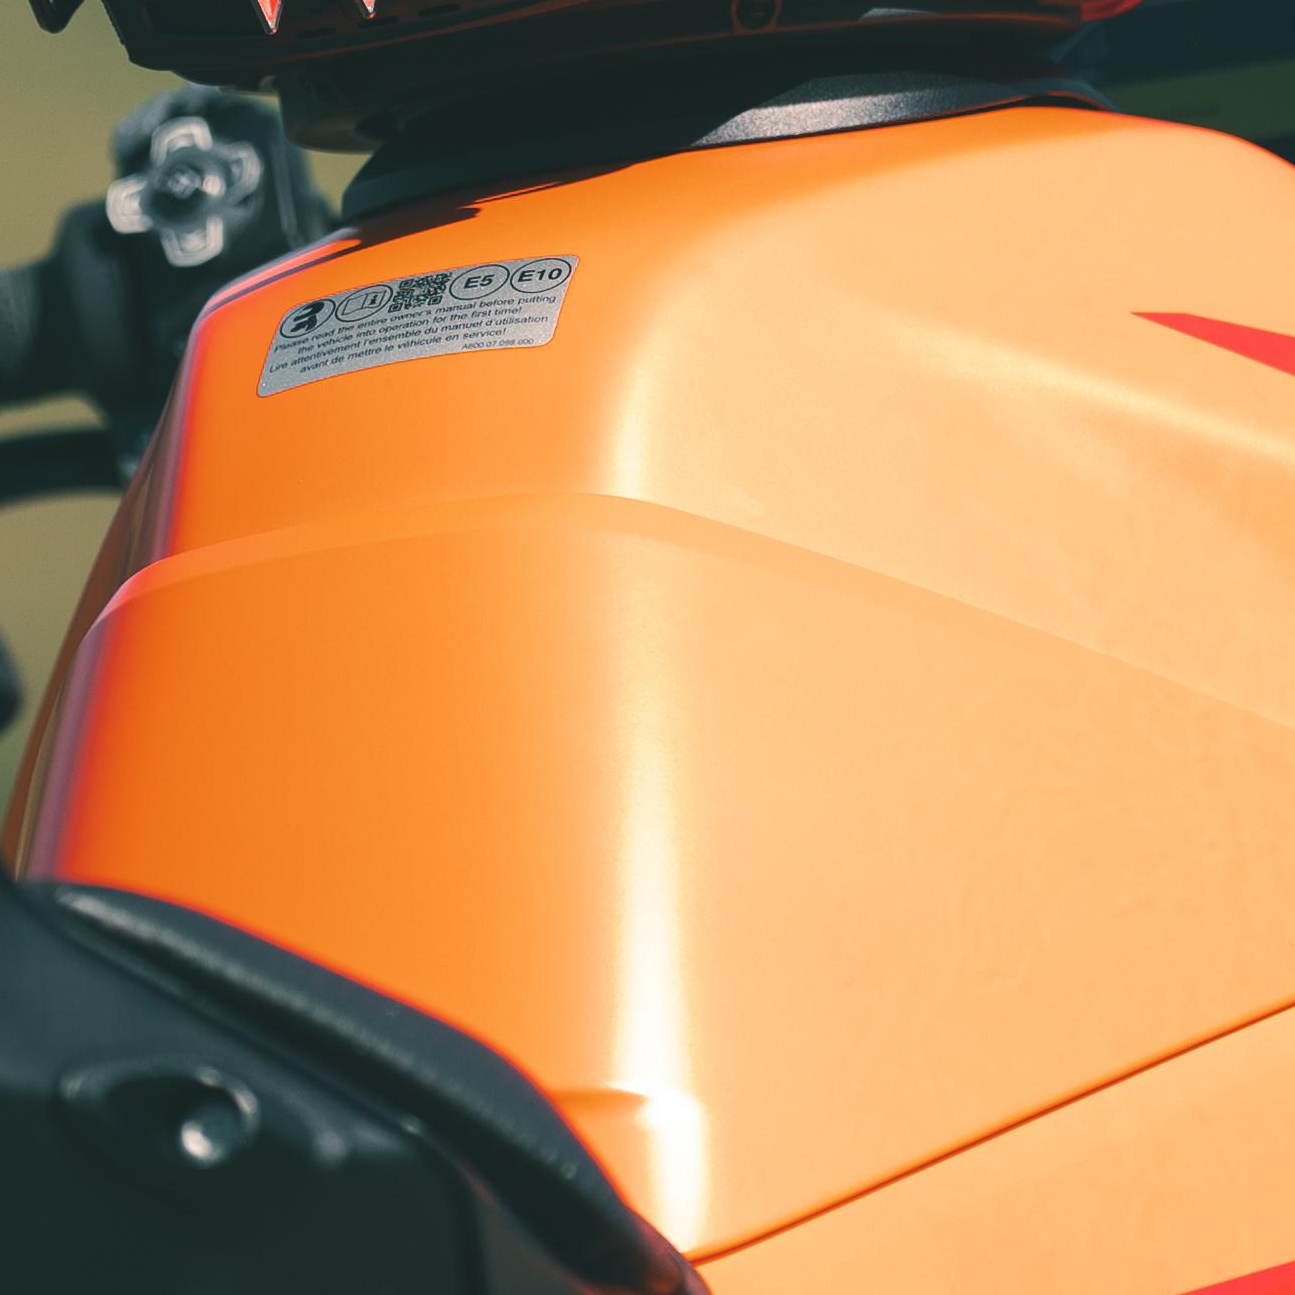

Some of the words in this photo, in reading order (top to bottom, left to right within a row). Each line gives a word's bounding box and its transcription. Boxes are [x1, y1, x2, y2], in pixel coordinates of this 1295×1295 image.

[464, 274, 495, 289] E5
[517, 268, 563, 283] E10
[269, 361, 289, 373] Lire
[291, 341, 361, 366] attentivement
[363, 328, 422, 345] l'ensemble
[424, 324, 439, 335] du
[440, 319, 483, 333] manuel
[485, 315, 549, 328] d'utilisation
[274, 337, 309, 353] Please
[311, 329, 336, 340] read
[338, 325, 355, 334] the
[357, 316, 388, 328] entire
[390, 310, 432, 321] owner's
[435, 301, 477, 314] manual
[479, 298, 515, 308] before
[517, 294, 557, 305] putting
[298, 345, 315, 355] the
[317, 335, 354, 349] vehicle
[356, 329, 376, 339] into
[378, 319, 430, 334] operation
[433, 314, 448, 324] for
[450, 311, 468, 322] the
[471, 308, 492, 319] first
[494, 306, 523, 316] time!
[300, 359, 330, 373] avant
[331, 355, 345, 365] de
[347, 345, 382, 360] mettre
[384, 342, 395, 352] le
[445, 333, 460, 342] en
[462, 327, 507, 339] service!
